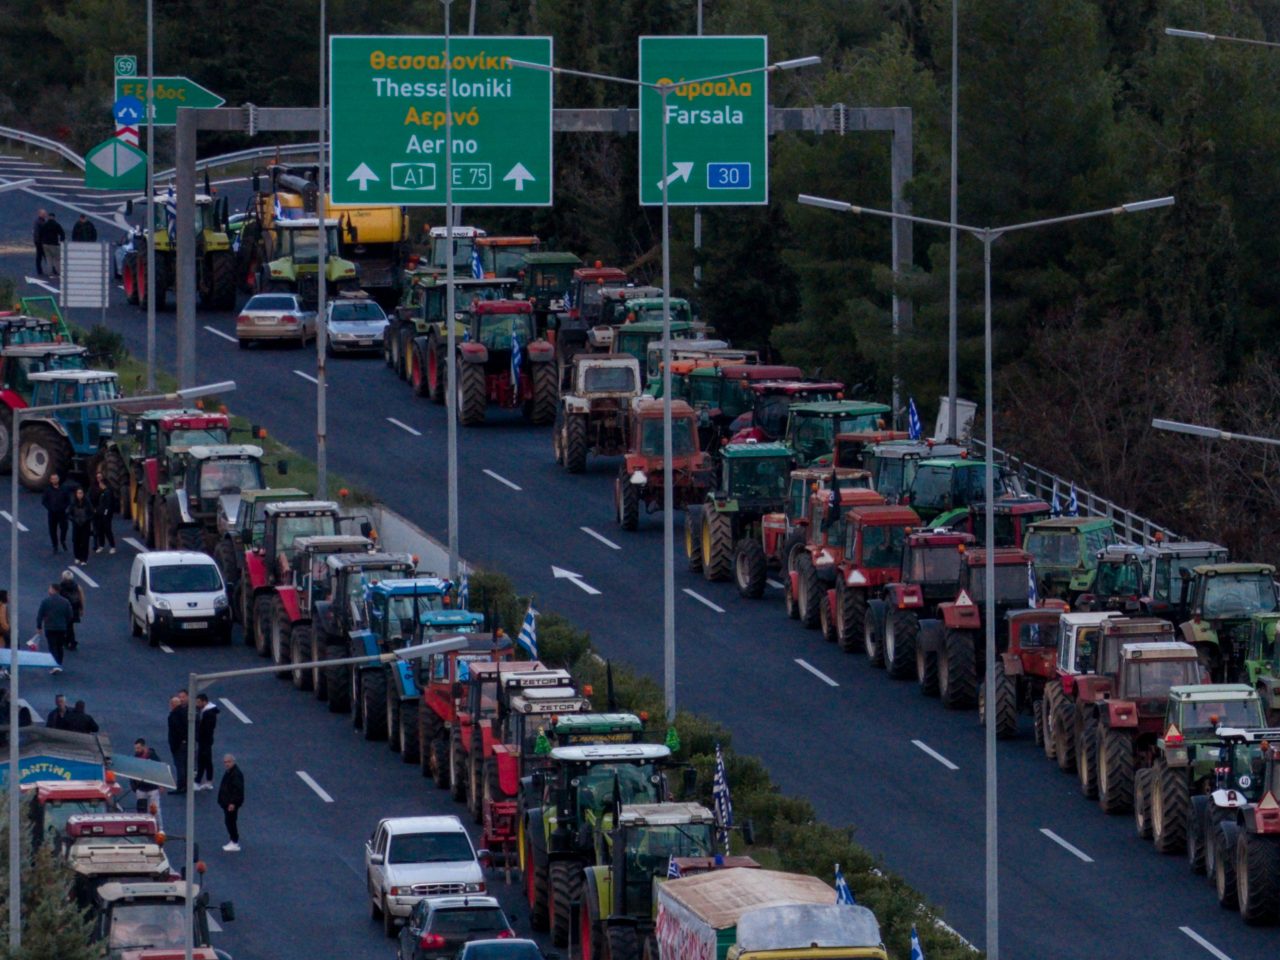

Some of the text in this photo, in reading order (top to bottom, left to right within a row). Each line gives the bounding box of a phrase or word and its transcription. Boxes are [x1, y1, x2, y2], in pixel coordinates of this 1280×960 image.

[119, 62, 132, 72] 59
[370, 51, 513, 70] Θεσσαλονίκη
[372, 78, 512, 97] Thessaloniki
[404, 106, 480, 130] Αερνό
[665, 105, 744, 124] Farsala
[406, 134, 478, 153] Aerno
[404, 169, 424, 184] A1
[452, 169, 487, 184] E 75
[718, 168, 740, 184] 30
